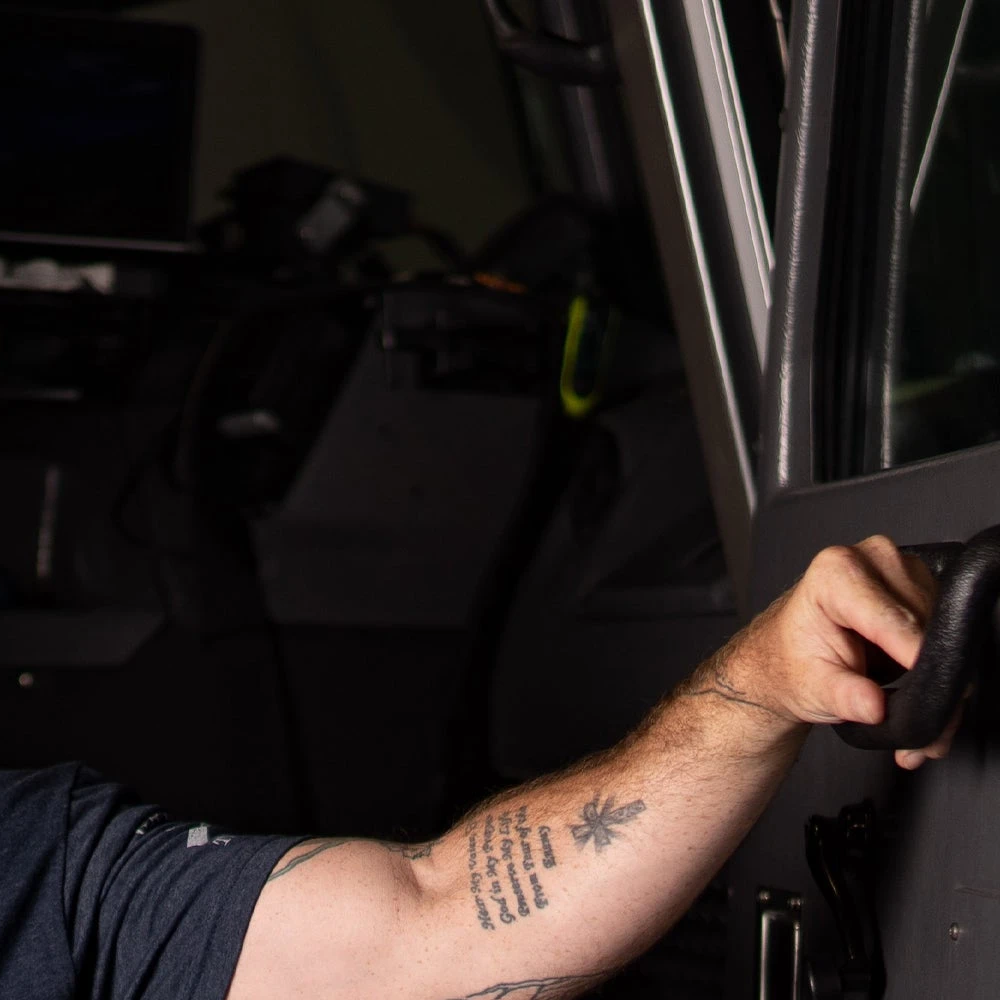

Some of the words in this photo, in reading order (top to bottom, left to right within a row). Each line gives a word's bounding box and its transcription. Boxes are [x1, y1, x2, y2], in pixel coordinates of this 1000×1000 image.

[515, 826, 531, 838] of
[500, 838, 513, 860] My
[521, 840, 534, 870] Fear
[538, 826, 556, 869] Enemy
[486, 856, 499, 877] My
[470, 872, 482, 894] My
[490, 881, 502, 894] in
[507, 862, 530, 916] Preserve
[530, 873, 548, 910] From
[476, 896, 495, 930] Hear
[490, 896, 516, 924] God
